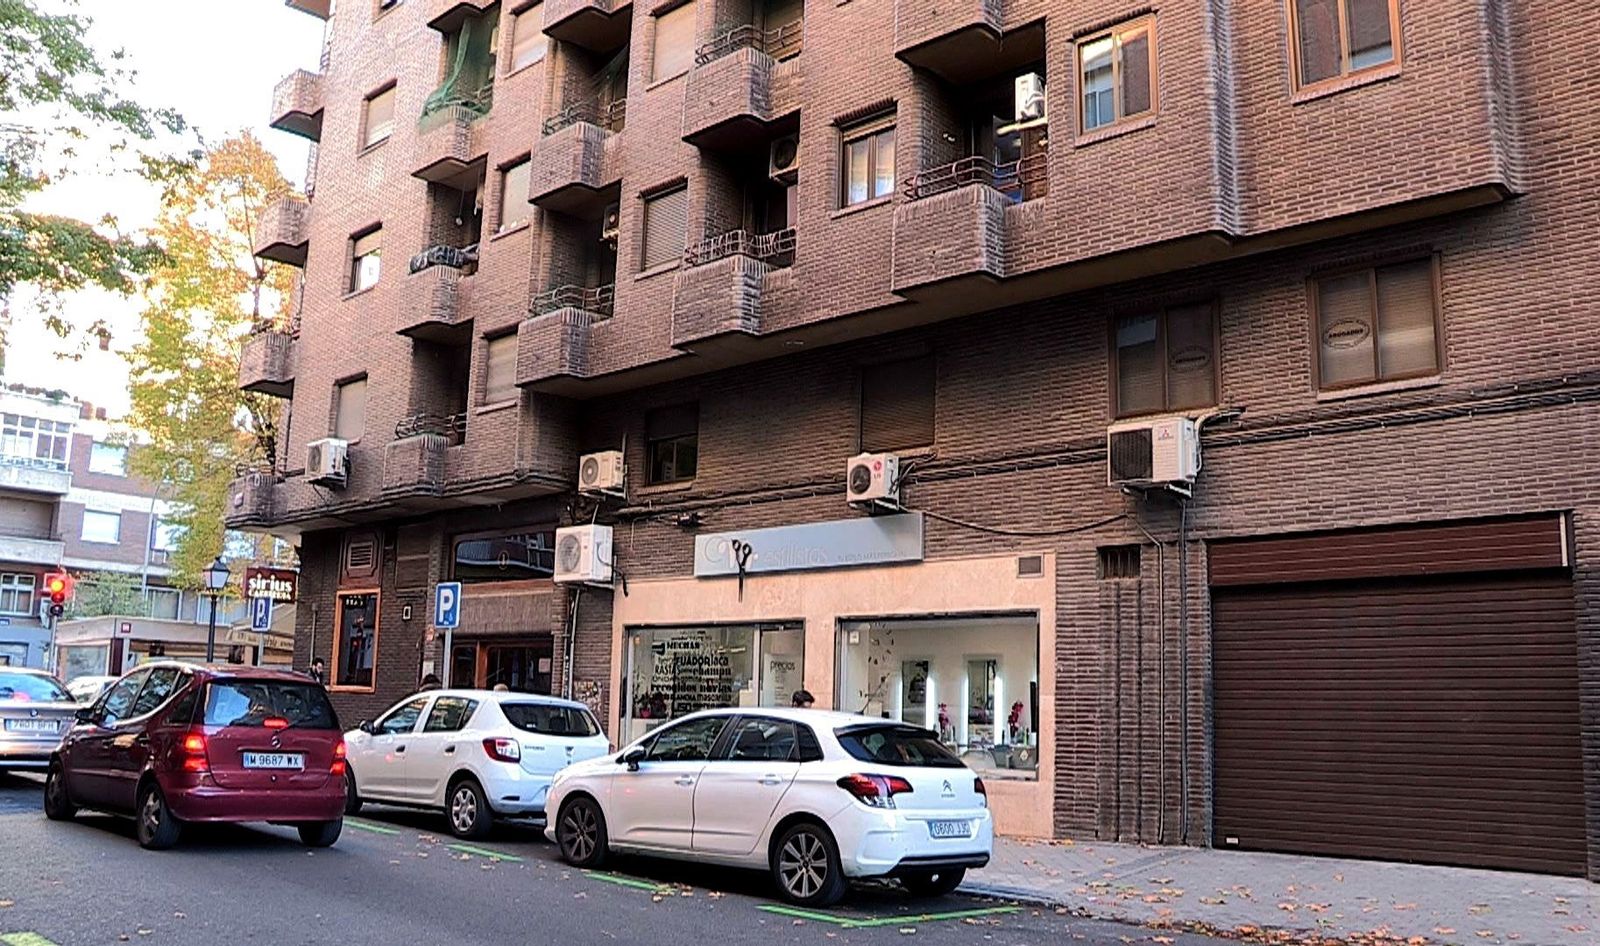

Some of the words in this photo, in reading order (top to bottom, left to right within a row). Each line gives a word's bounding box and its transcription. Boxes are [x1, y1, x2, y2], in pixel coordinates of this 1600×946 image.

[248, 573, 293, 593] sirius
[255, 599, 266, 626] P
[438, 588, 454, 623] P
[259, 755, 284, 766] 9687
[287, 756, 299, 766] WX
